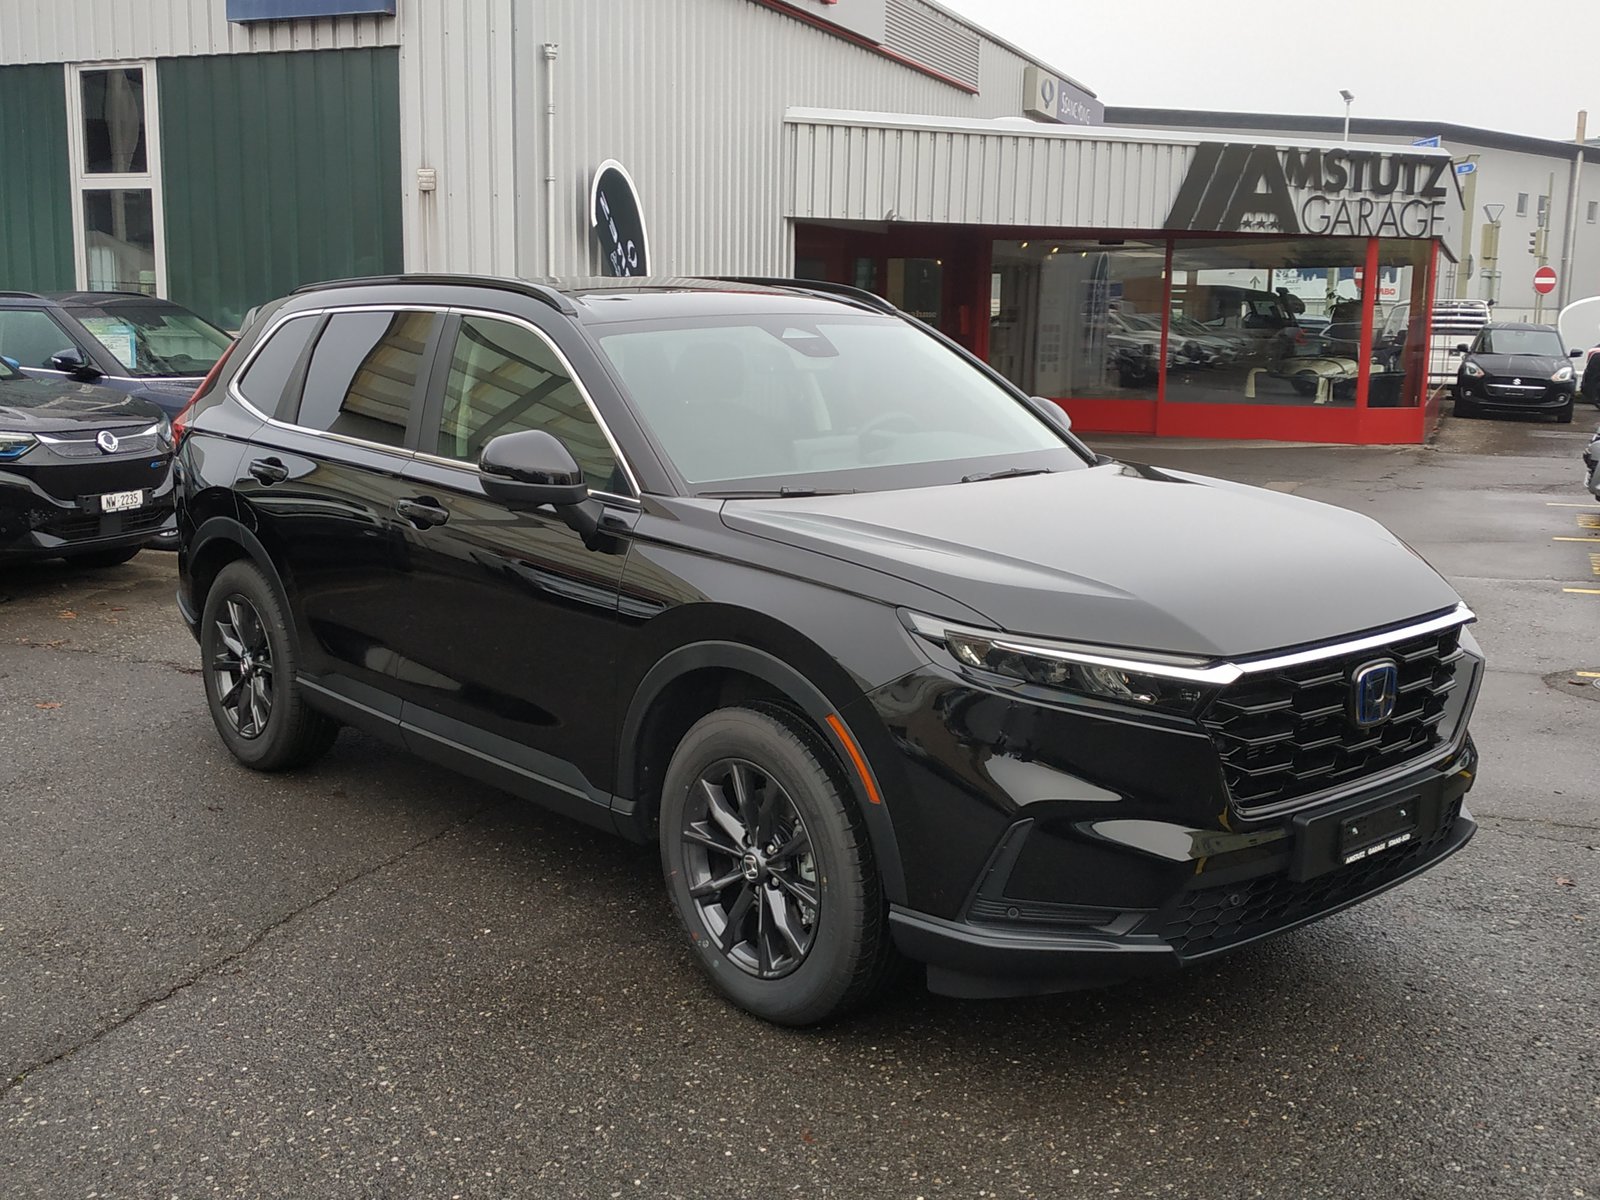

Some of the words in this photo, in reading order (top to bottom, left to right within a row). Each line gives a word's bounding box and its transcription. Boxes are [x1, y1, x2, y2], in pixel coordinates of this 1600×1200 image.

[1214, 143, 1447, 233] AMSTUTZ
[1301, 194, 1447, 239] GARAGE
[120, 493, 138, 506] 2235
